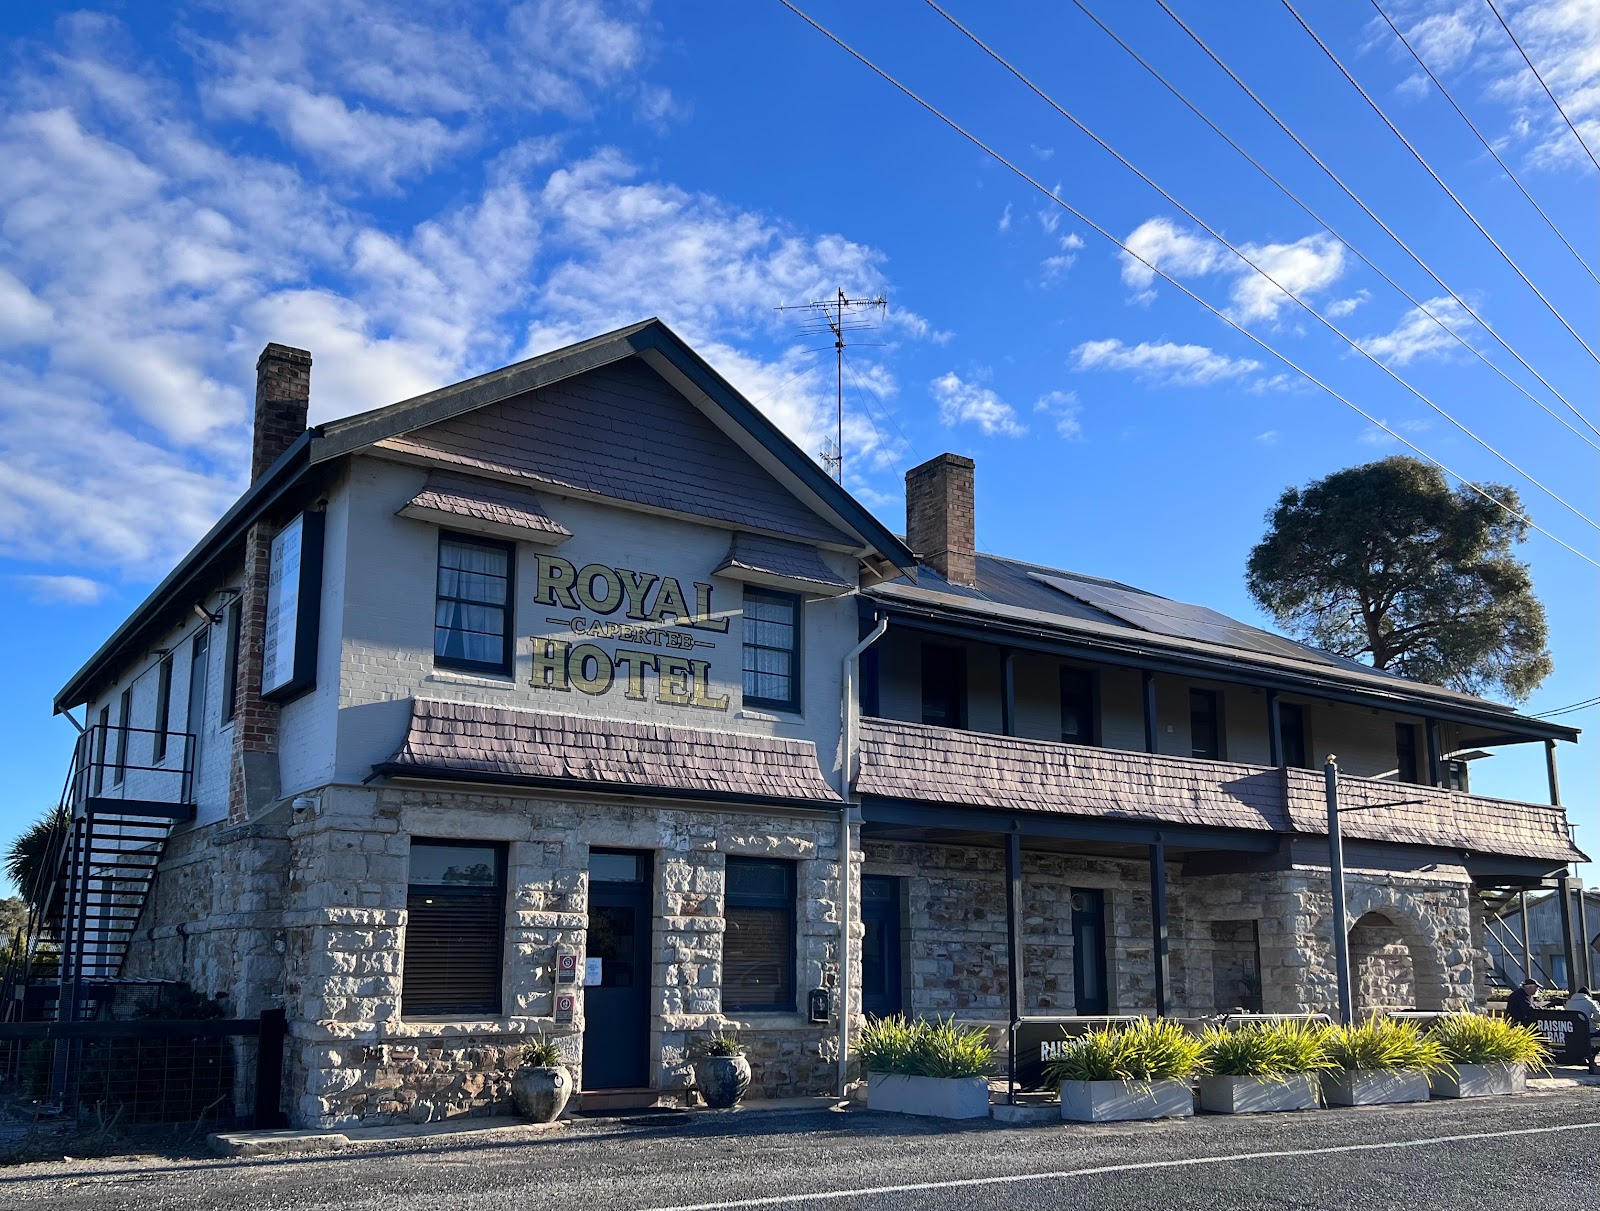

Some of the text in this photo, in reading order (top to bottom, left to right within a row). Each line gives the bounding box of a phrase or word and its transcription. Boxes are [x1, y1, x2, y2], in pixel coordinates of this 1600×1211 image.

[534, 553, 729, 633] ROYAL
[570, 617, 694, 649] CAPERTEE
[529, 636, 729, 712] HOTEL
[1537, 1020, 1574, 1032] RAISING
[1548, 1032, 1566, 1043] BAR
[1041, 1040, 1078, 1062] RAIS
